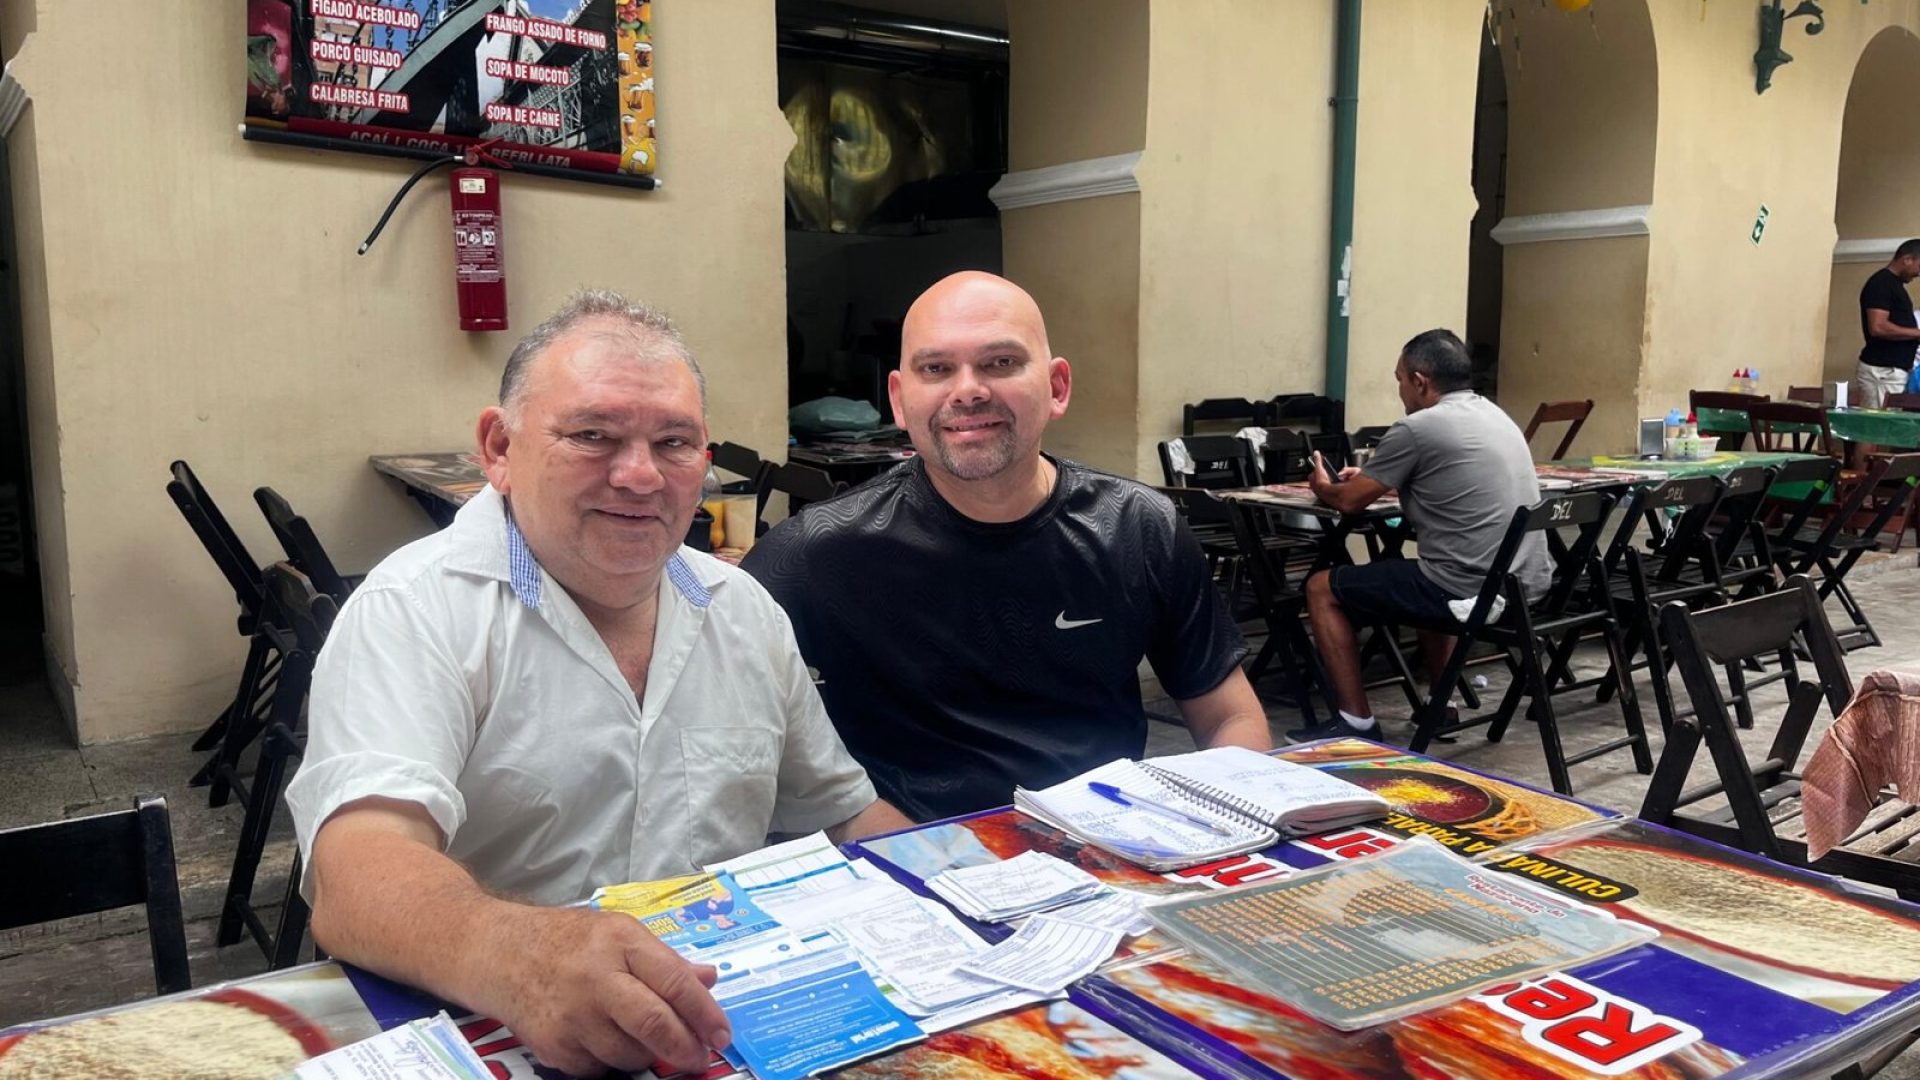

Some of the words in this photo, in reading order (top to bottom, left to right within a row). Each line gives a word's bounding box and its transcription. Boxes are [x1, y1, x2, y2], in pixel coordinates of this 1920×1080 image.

[356, 6, 419, 28] ACEBOLADO
[487, 14, 525, 34] FRANGO
[528, 23, 562, 41] ASSADO
[564, 29, 576, 43] DE
[578, 32, 606, 49] FORNO
[312, 42, 351, 60] PORCO
[354, 48, 401, 68] GUISADO
[487, 61, 512, 78] SOPA
[515, 64, 527, 79] DE
[312, 85, 375, 107] CALABRESA
[378, 94, 408, 110] FRITA
[487, 105, 512, 122] SOPA
[515, 108, 527, 122] DE
[529, 110, 560, 127] CARNE
[537, 153, 571, 168] LATA
[1550, 500, 1572, 520] DEL
